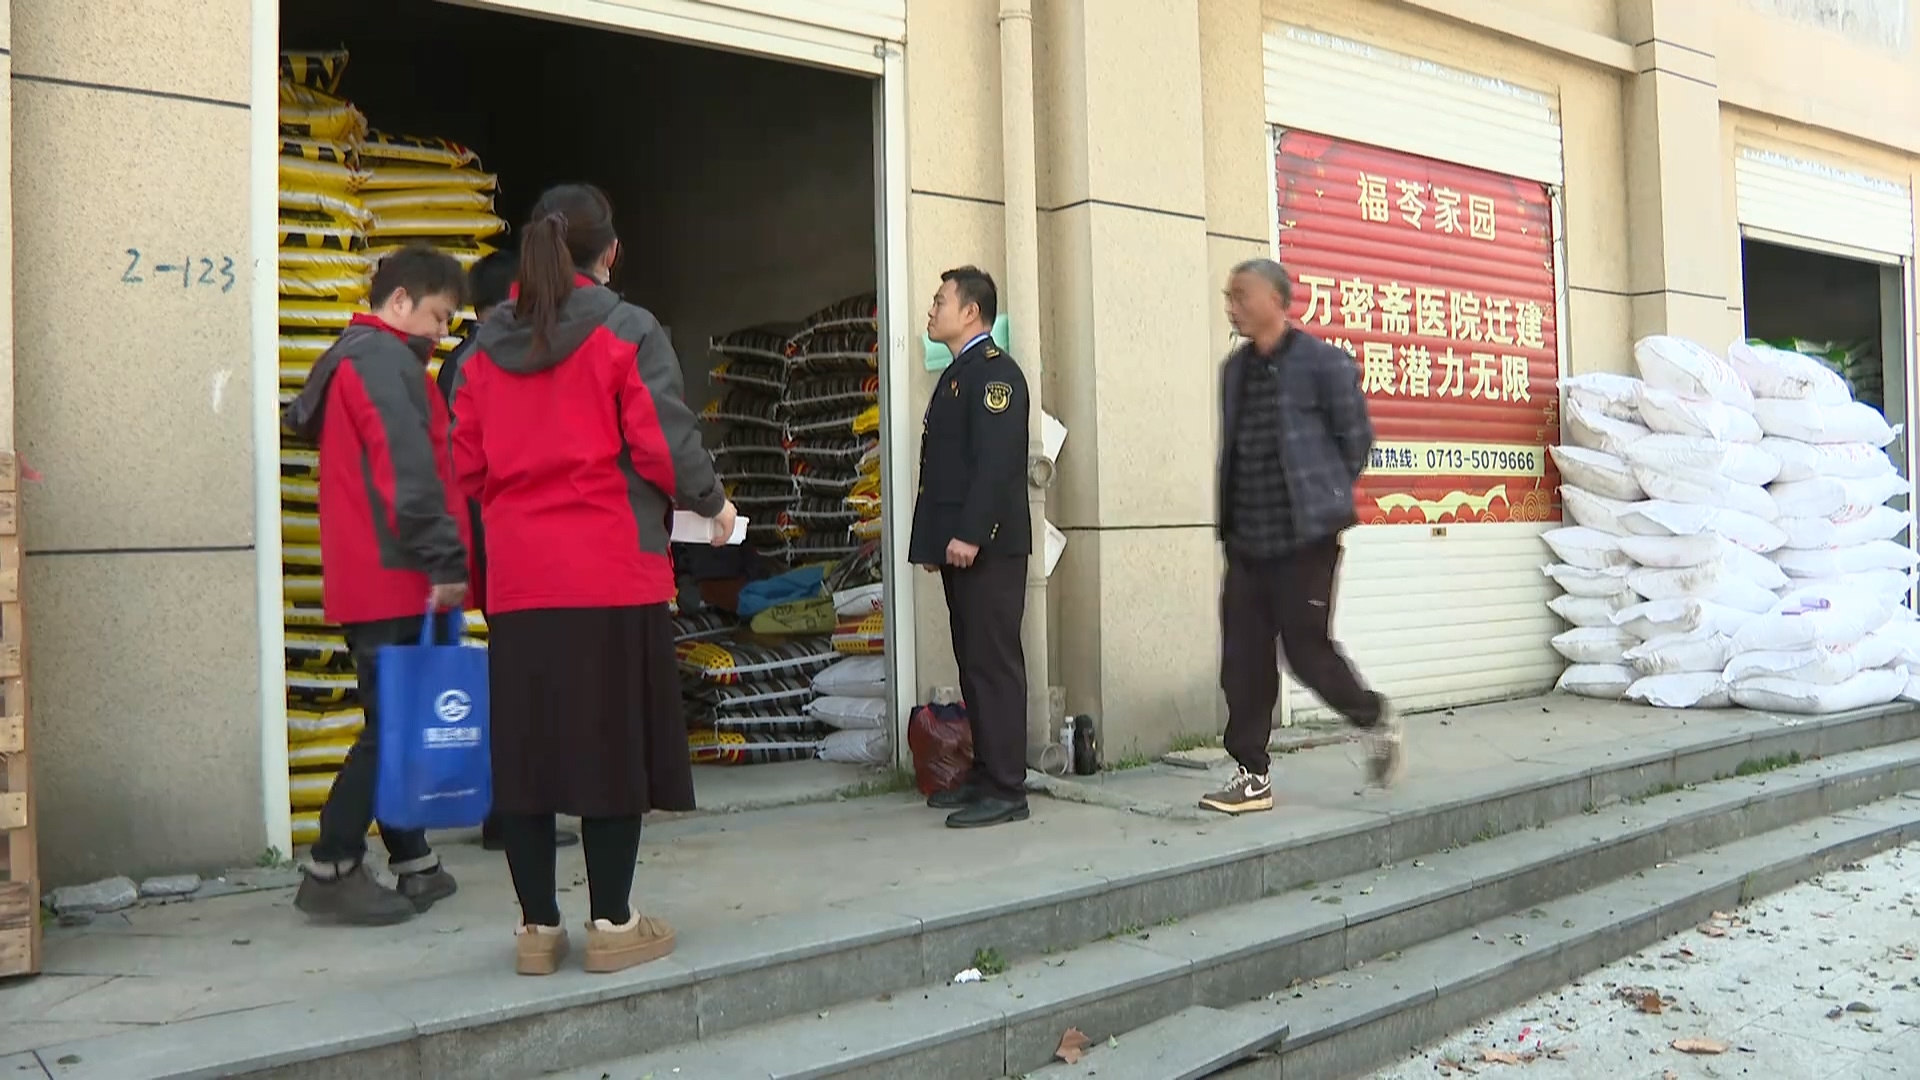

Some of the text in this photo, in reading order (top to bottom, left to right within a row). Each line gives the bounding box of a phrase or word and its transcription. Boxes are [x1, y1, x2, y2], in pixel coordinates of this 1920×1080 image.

[1357, 171, 1496, 241] 福苓家园
[121, 248, 236, 294] 2-123
[1299, 273, 1545, 349] 万密斋医院迁建
[1364, 447, 1535, 471] 富热线： 0713-5079666
